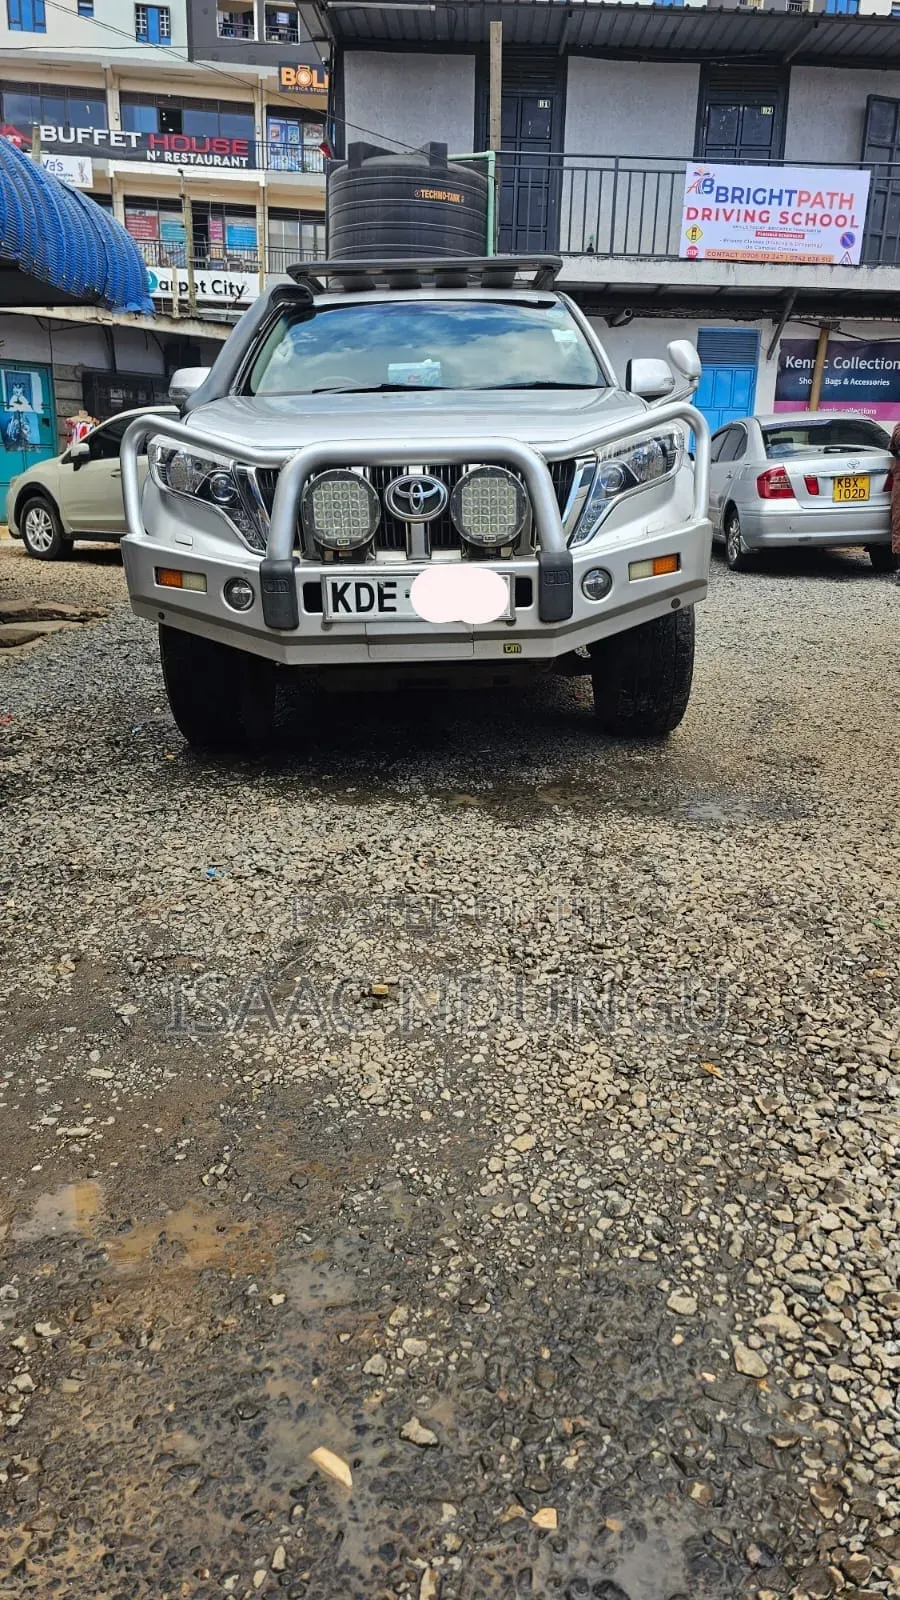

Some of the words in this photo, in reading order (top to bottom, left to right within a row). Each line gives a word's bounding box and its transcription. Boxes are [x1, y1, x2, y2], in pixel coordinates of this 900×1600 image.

[40, 125, 141, 148] BUFFET
[149, 133, 248, 156] HOUSE
[146, 150, 160, 161] N'
[164, 151, 248, 168] RESTAURANT
[715, 186, 855, 211] BRIGHTPATH
[686, 207, 770, 224] DRIVING
[779, 211, 859, 229] SCHOOL
[211, 279, 245, 300] City
[825, 377, 842, 387] Bags
[843, 377, 849, 385] &
[850, 377, 890, 386] Accessories
[837, 477, 858, 488] KBX
[838, 488, 866, 499] 102D
[330, 581, 397, 613] KDE
